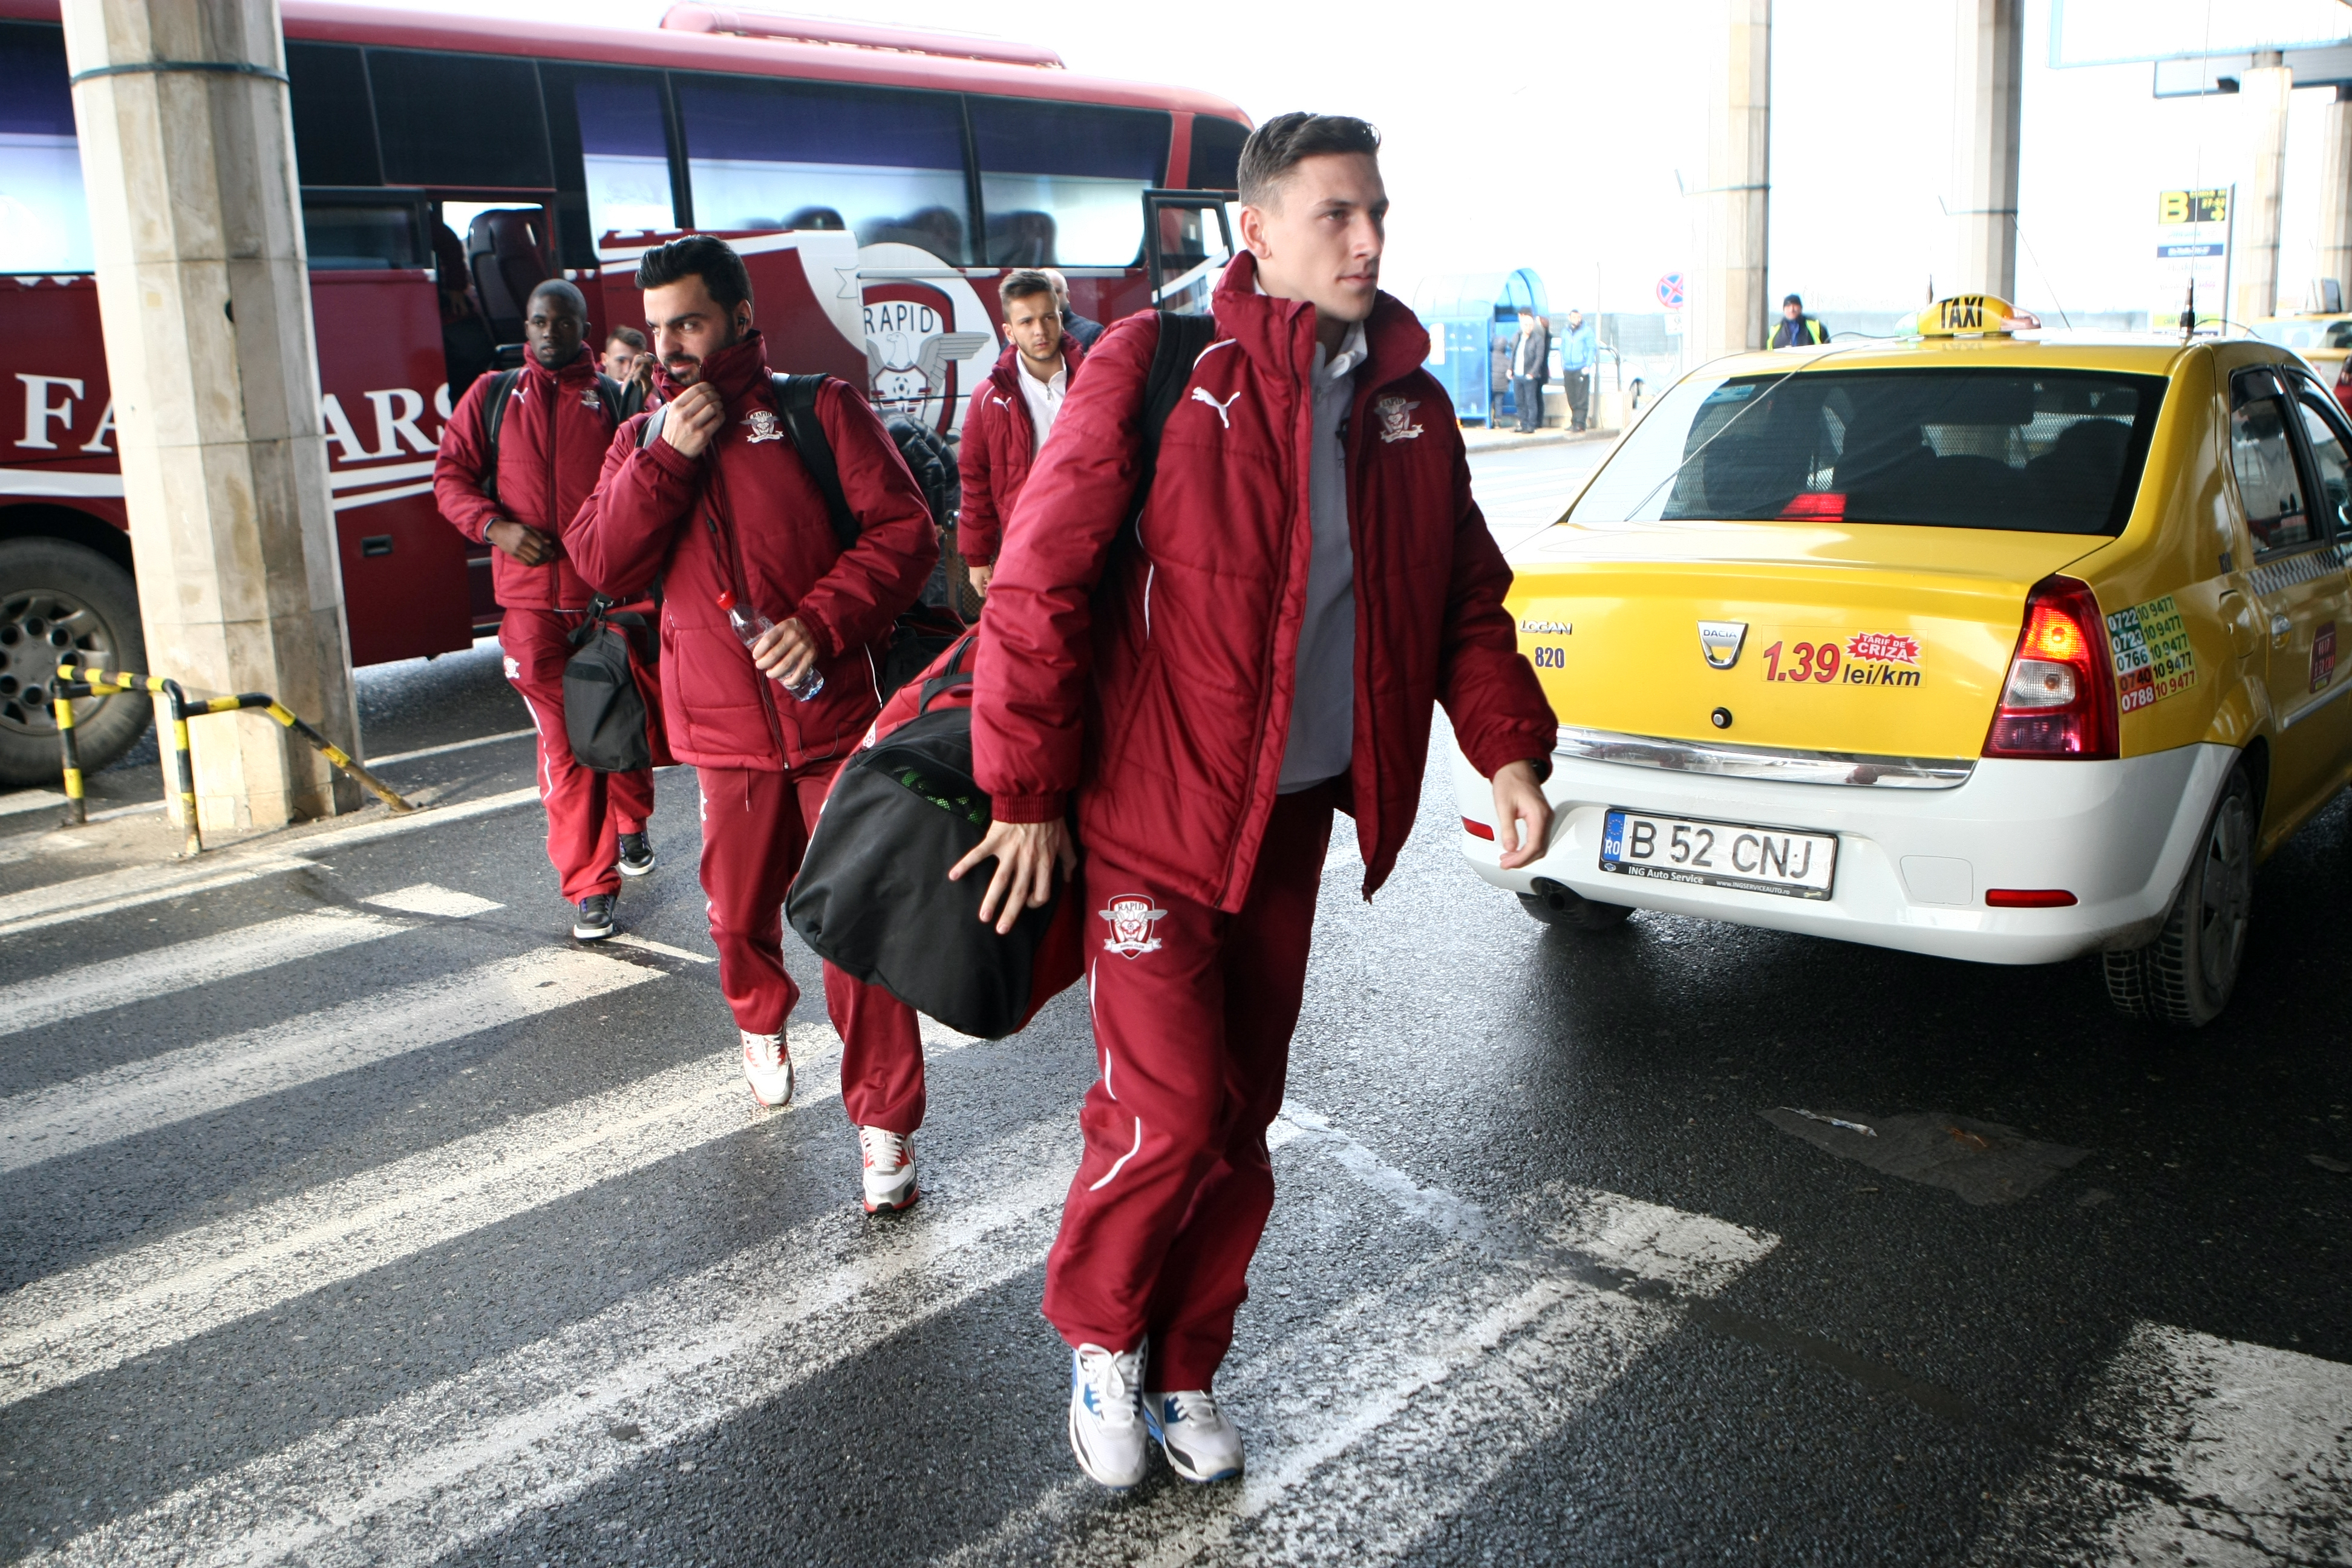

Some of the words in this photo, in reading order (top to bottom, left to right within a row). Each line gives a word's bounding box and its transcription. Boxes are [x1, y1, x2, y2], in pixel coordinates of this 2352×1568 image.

[2160, 191, 2189, 223] B
[863, 304, 933, 335] RAPID
[1938, 296, 1984, 328] TAXI
[1520, 619, 1572, 635] LOGAN
[2107, 609, 2139, 632] 0722
[2137, 607, 2148, 621] 10
[2149, 596, 2174, 616] 9477
[1703, 629, 1737, 638] DACIA
[1862, 635, 1890, 645] TARIF
[1893, 639, 1906, 648] DE
[2112, 629, 2143, 652] 0723
[2144, 625, 2156, 641] 10
[2156, 616, 2181, 636] 9477
[1535, 647, 1564, 668] 820
[1763, 641, 1840, 683] 1.39
[1843, 664, 1920, 686] lei/km
[1857, 642, 1908, 660] CRIZA
[2116, 648, 2148, 671] 0766
[2149, 644, 2161, 660] 10
[2163, 633, 2187, 656] 9477
[2120, 668, 2151, 691] 0740
[2153, 662, 2165, 679] 10
[2166, 651, 2191, 674] 9477
[2122, 686, 2154, 711] 0788
[2155, 681, 2167, 697] 10
[2169, 670, 2195, 692] 9477
[1604, 840, 1620, 855] RO
[1630, 820, 1656, 859] B
[1670, 825, 1715, 867] 52
[1732, 834, 1812, 879] CNJ
[1628, 866, 1645, 876] ING
[1647, 871, 1669, 880] Auto
[1671, 872, 1704, 884] Service
[1716, 880, 1790, 895] www.INGSERVICEAUTO.ro
[1117, 903, 1145, 911] RAPID
